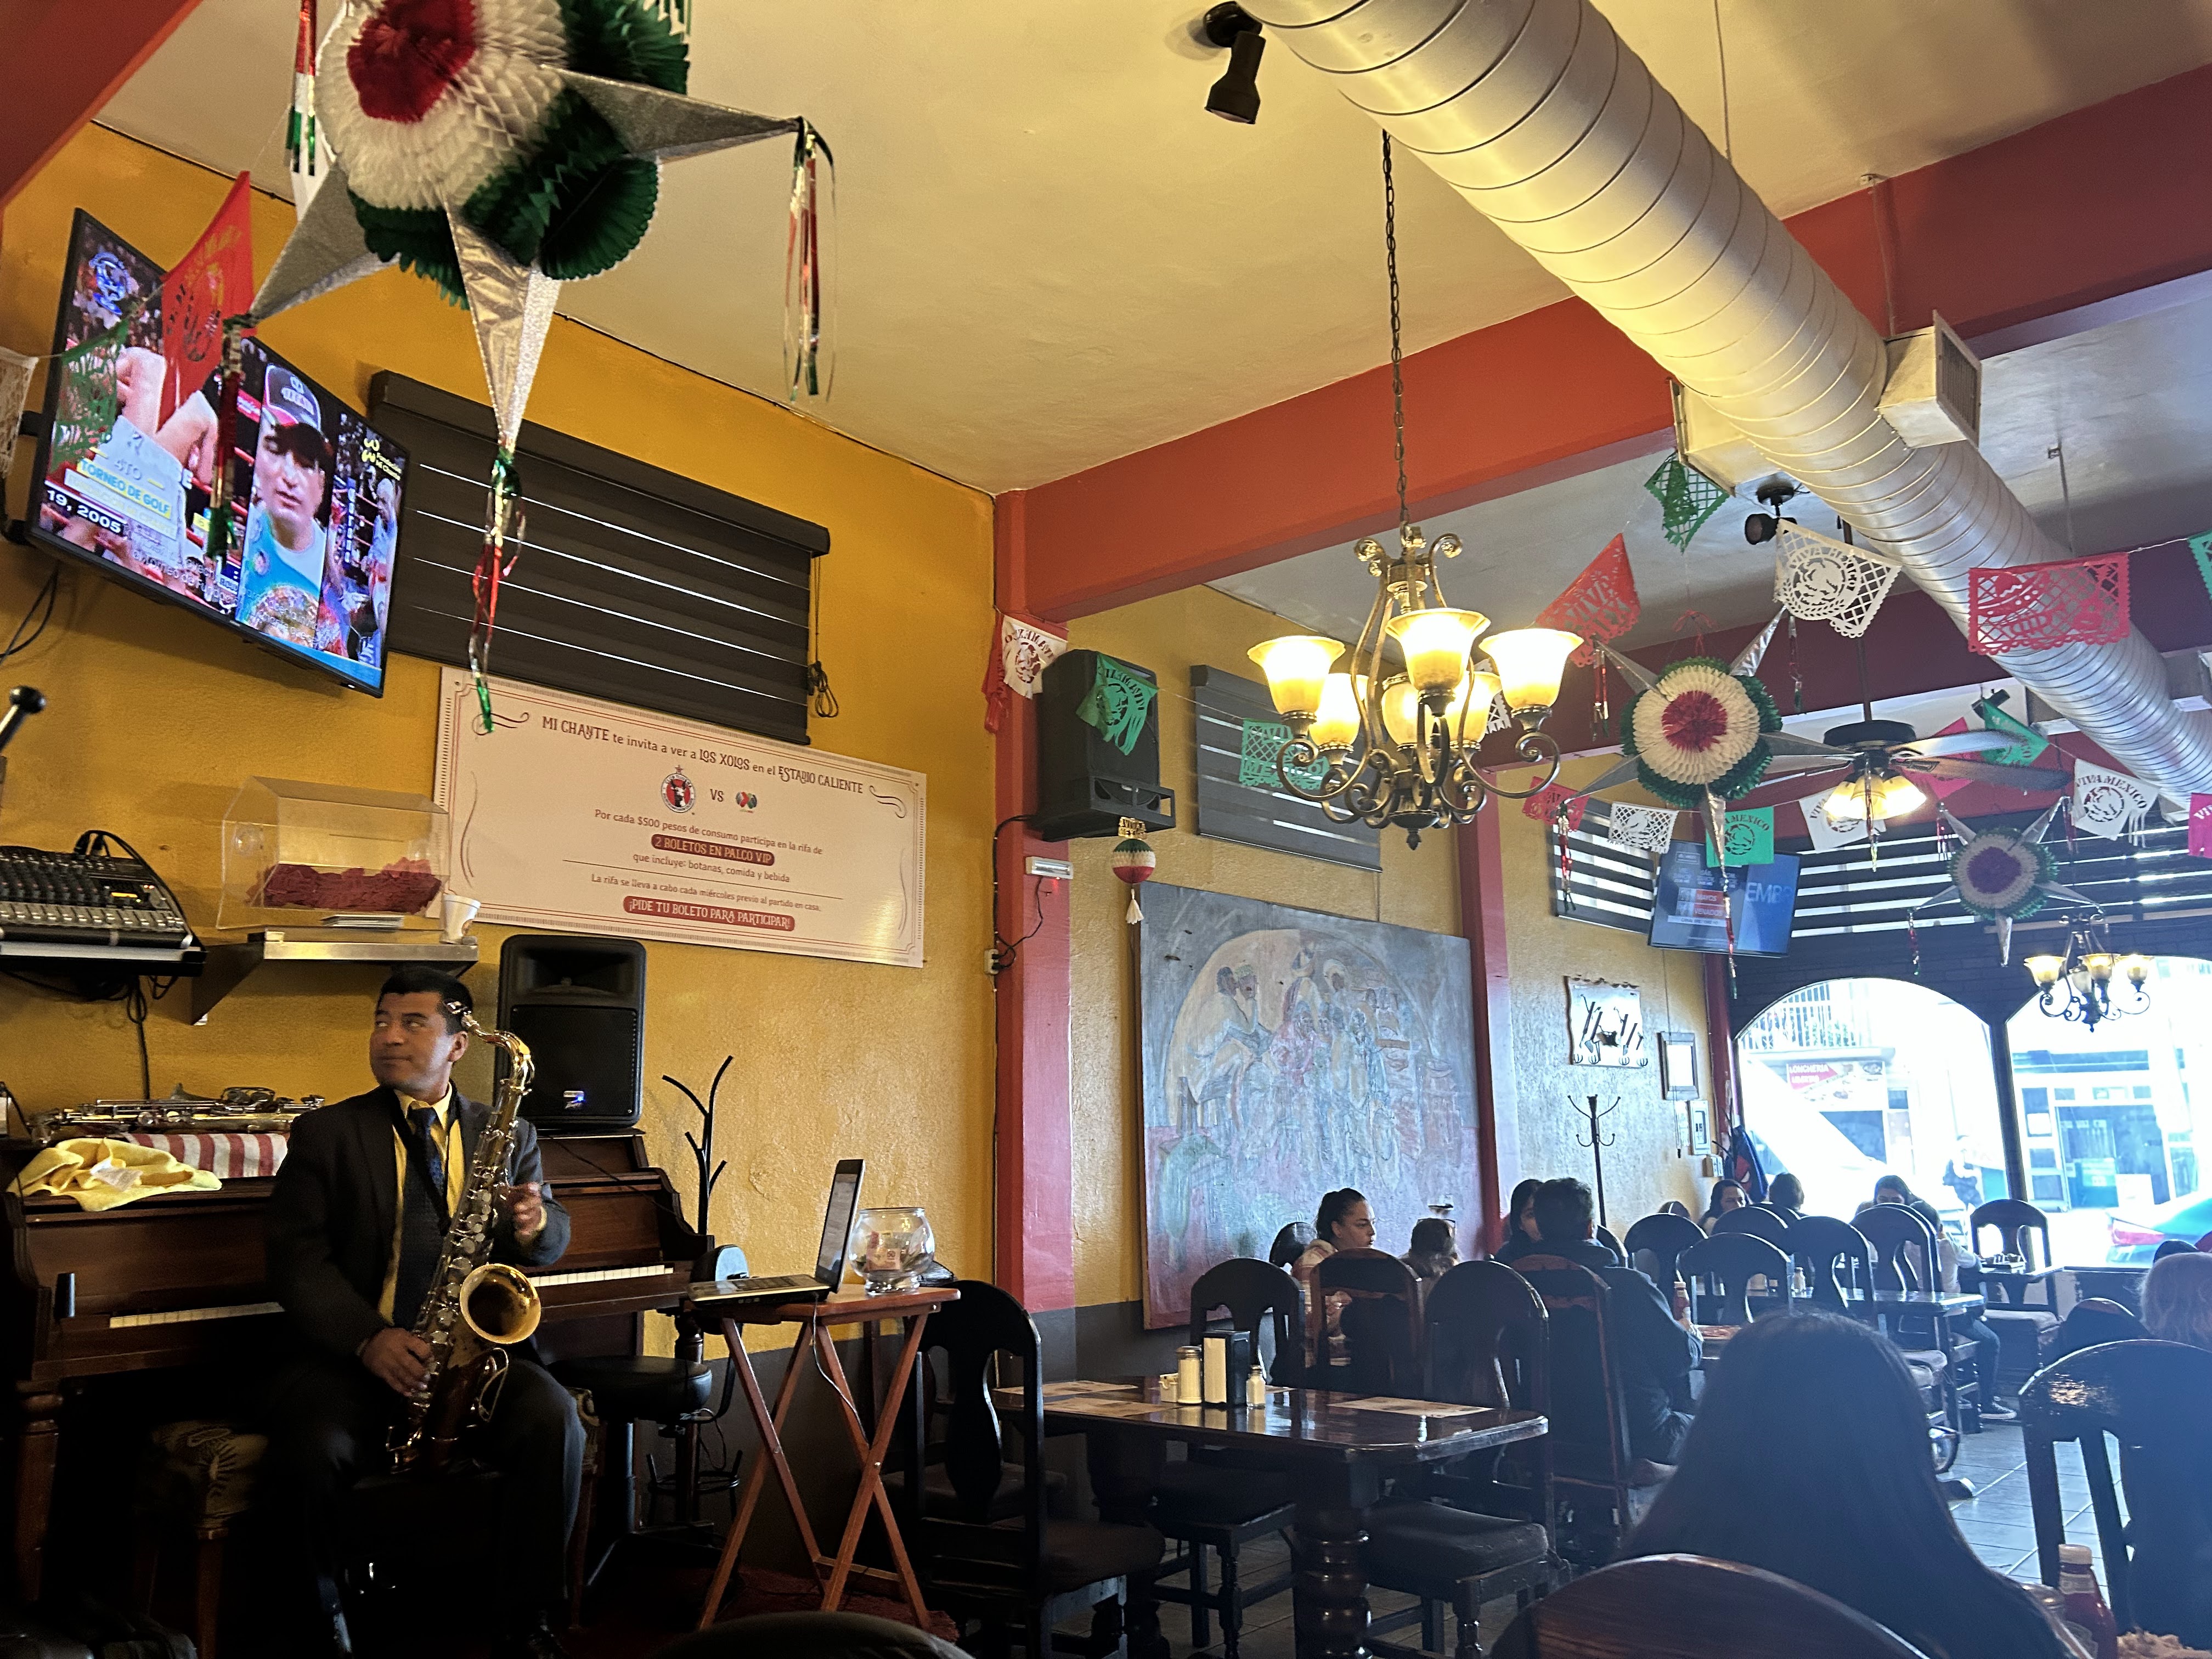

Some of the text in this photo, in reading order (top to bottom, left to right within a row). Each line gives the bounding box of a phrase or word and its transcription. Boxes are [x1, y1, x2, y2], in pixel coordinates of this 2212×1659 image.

[80, 458, 171, 515] TORNEO DE GOLF
[47, 489, 122, 534] 19, 2005
[543, 715, 557, 731] MI
[561, 720, 610, 741] CHANTE
[613, 733, 624, 744] te
[627, 735, 658, 751] invita
[661, 744, 668, 753] a
[670, 747, 688, 757] ver
[699, 749, 716, 763] LOS
[719, 753, 751, 770] XOLOS
[752, 763, 764, 772] en
[767, 765, 776, 775] el
[778, 765, 816, 784] ESTADIO
[817, 774, 864, 794] CALIENTE
[710, 788, 724, 802] VS
[2075, 774, 2147, 809] VIVA MEXICO
[595, 809, 611, 820] Por
[613, 814, 635, 823] cada
[637, 816, 660, 828] $500
[662, 822, 687, 832] pesos
[689, 825, 699, 834] de
[702, 828, 738, 840] consumo
[741, 834, 776, 848] participa
[789, 842, 796, 850] la
[798, 844, 811, 853] rifa
[812, 847, 823, 855] de
[1729, 814, 1770, 831] MEXICO
[655, 836, 772, 864] 2 BOLETOS EN PALCO VIP
[633, 854, 650, 863] que
[689, 860, 724, 874] botanas,
[726, 866, 755, 878] comida
[757, 872, 763, 881] y
[764, 871, 791, 883] bebida
[591, 873, 601, 883] La
[603, 876, 619, 885] rifa
[631, 878, 651, 889] lleva
[659, 884, 678, 893] cabo
[680, 887, 697, 895] cada
[699, 888, 735, 900] miércoles
[736, 894, 759, 903] previo
[760, 896, 768, 904] al
[769, 898, 794, 908] partido
[629, 898, 791, 930] ¡PIDE TU BOLETO PARA PARTICIPAR!
